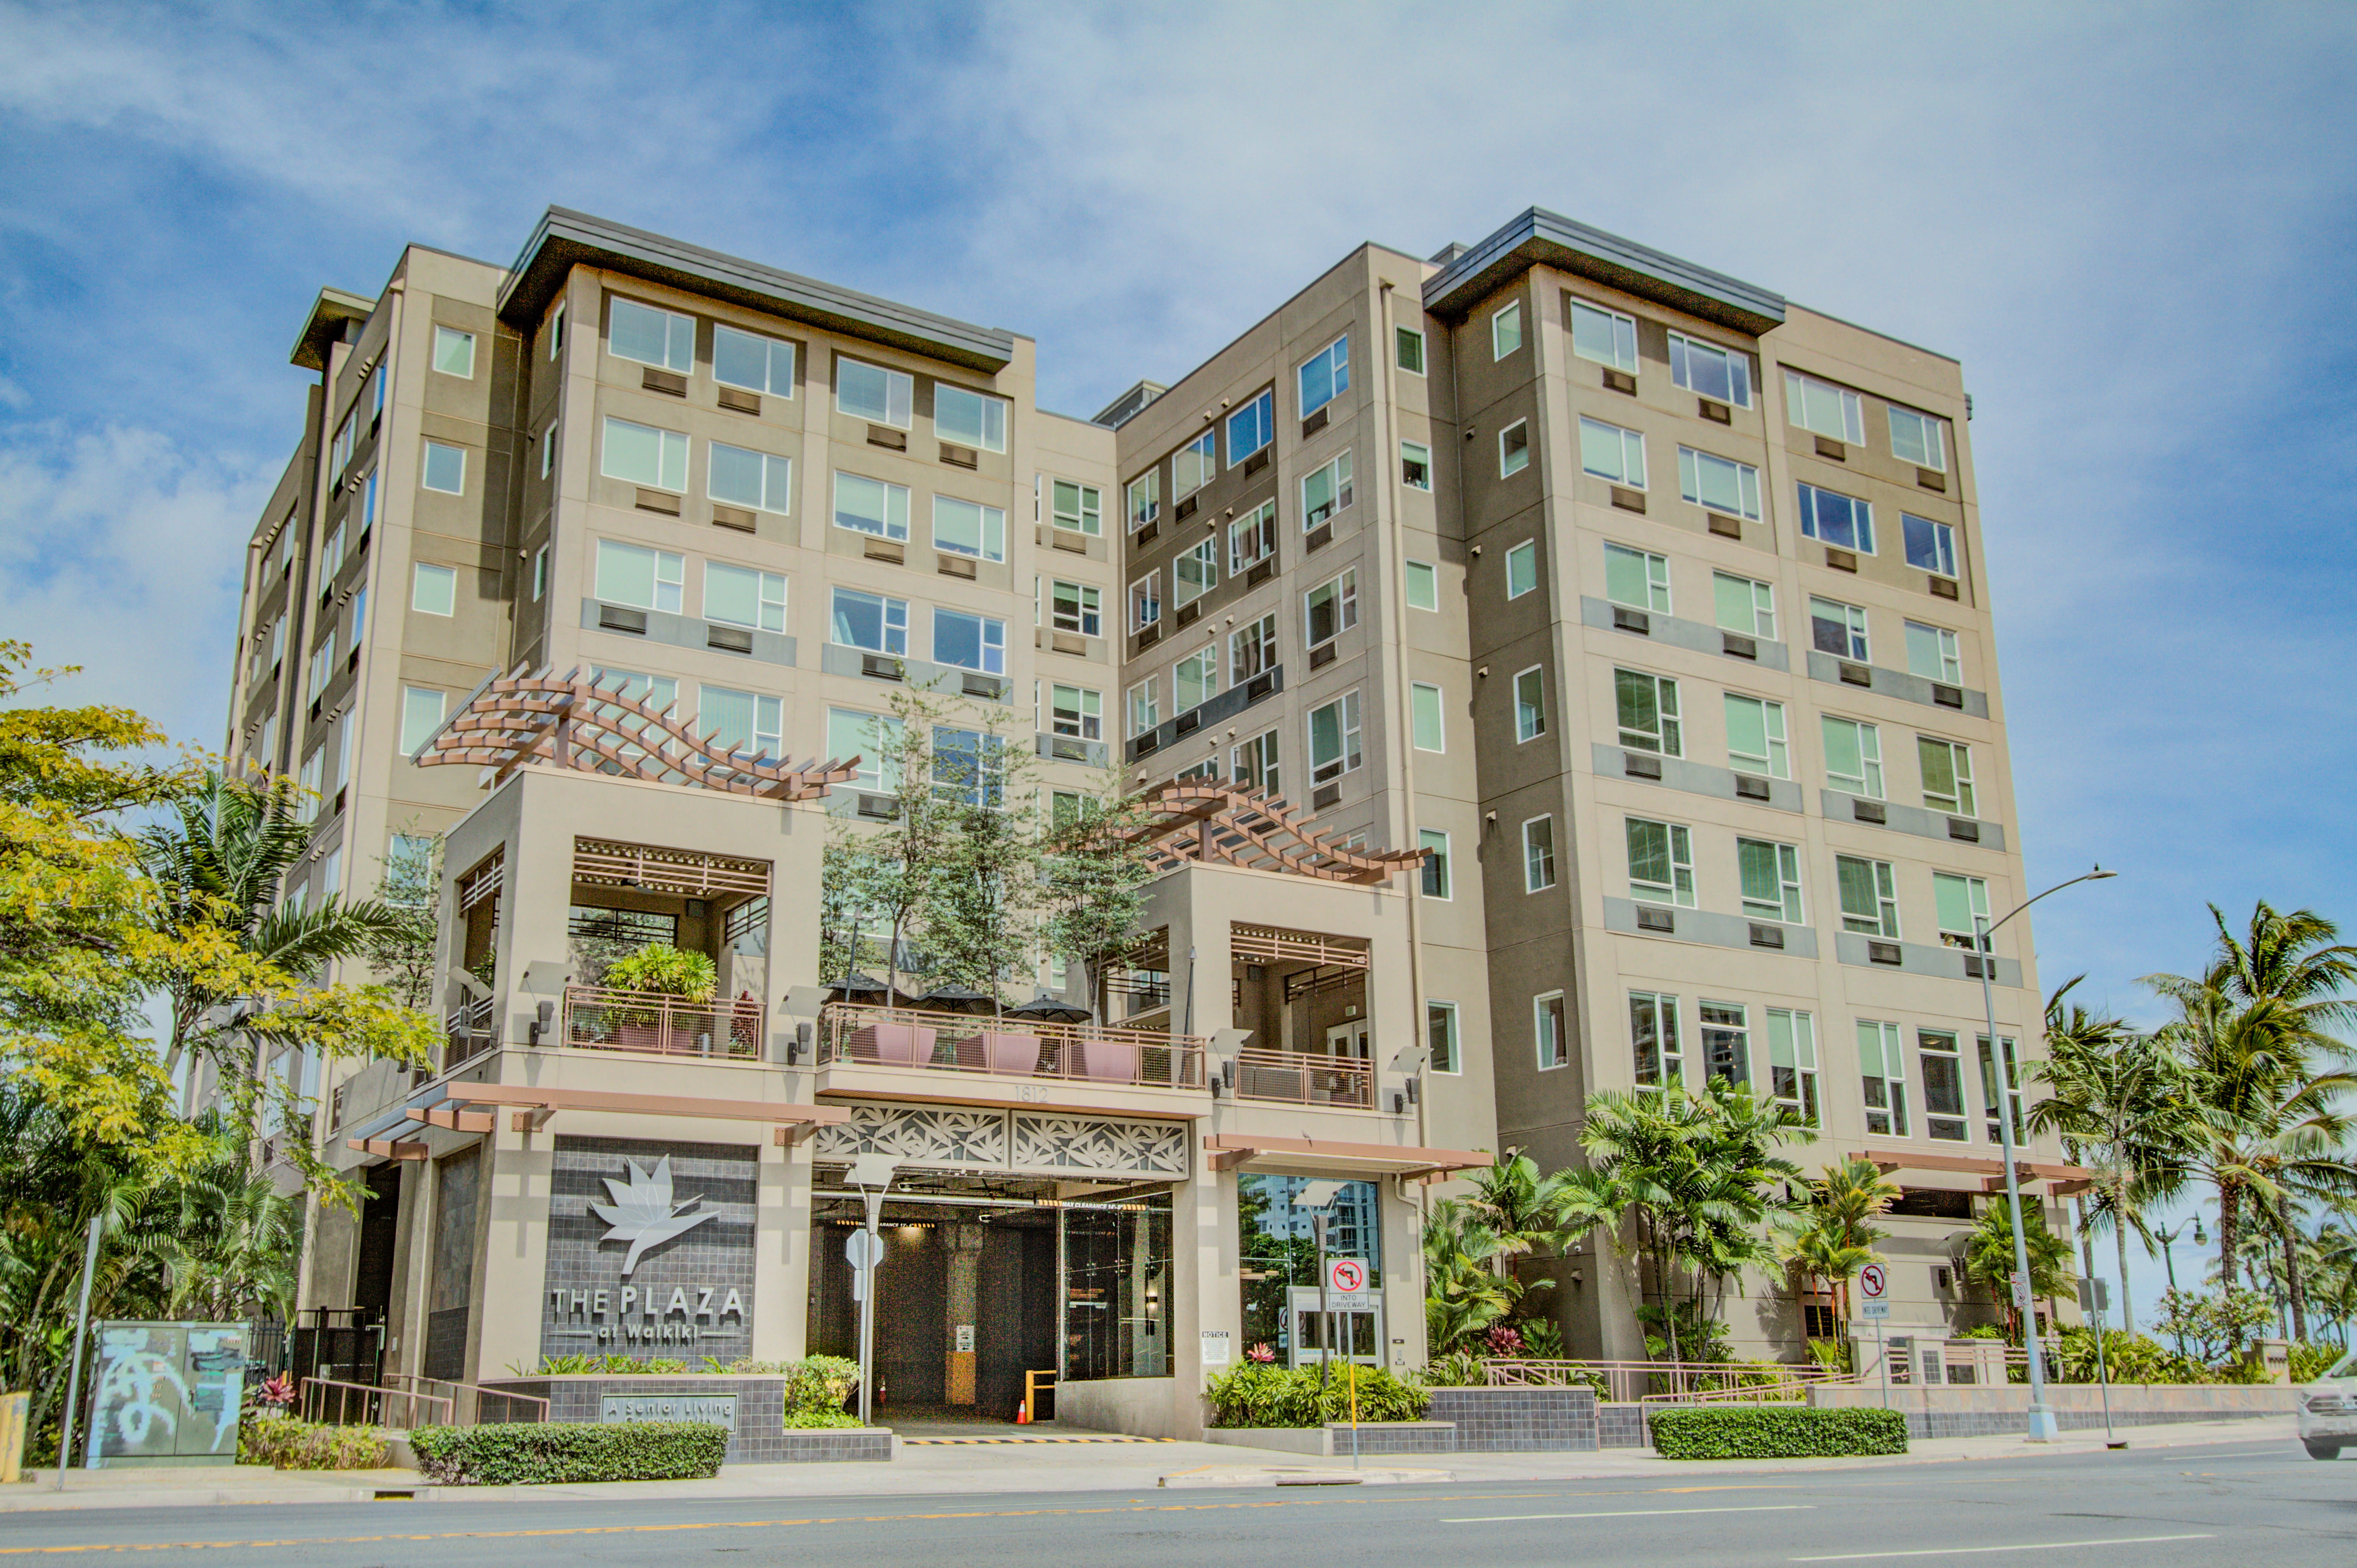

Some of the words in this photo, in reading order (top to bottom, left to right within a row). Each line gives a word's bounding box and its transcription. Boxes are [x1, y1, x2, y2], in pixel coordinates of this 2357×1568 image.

[1015, 1085, 1048, 1103] 1812
[552, 1289, 609, 1313] THE
[620, 1286, 744, 1314] PLAZA
[598, 1325, 617, 1338] at
[627, 1324, 698, 1339] Waikiki
[609, 1401, 618, 1413] A
[626, 1401, 678, 1413] Senior
[685, 1400, 733, 1415] Living
